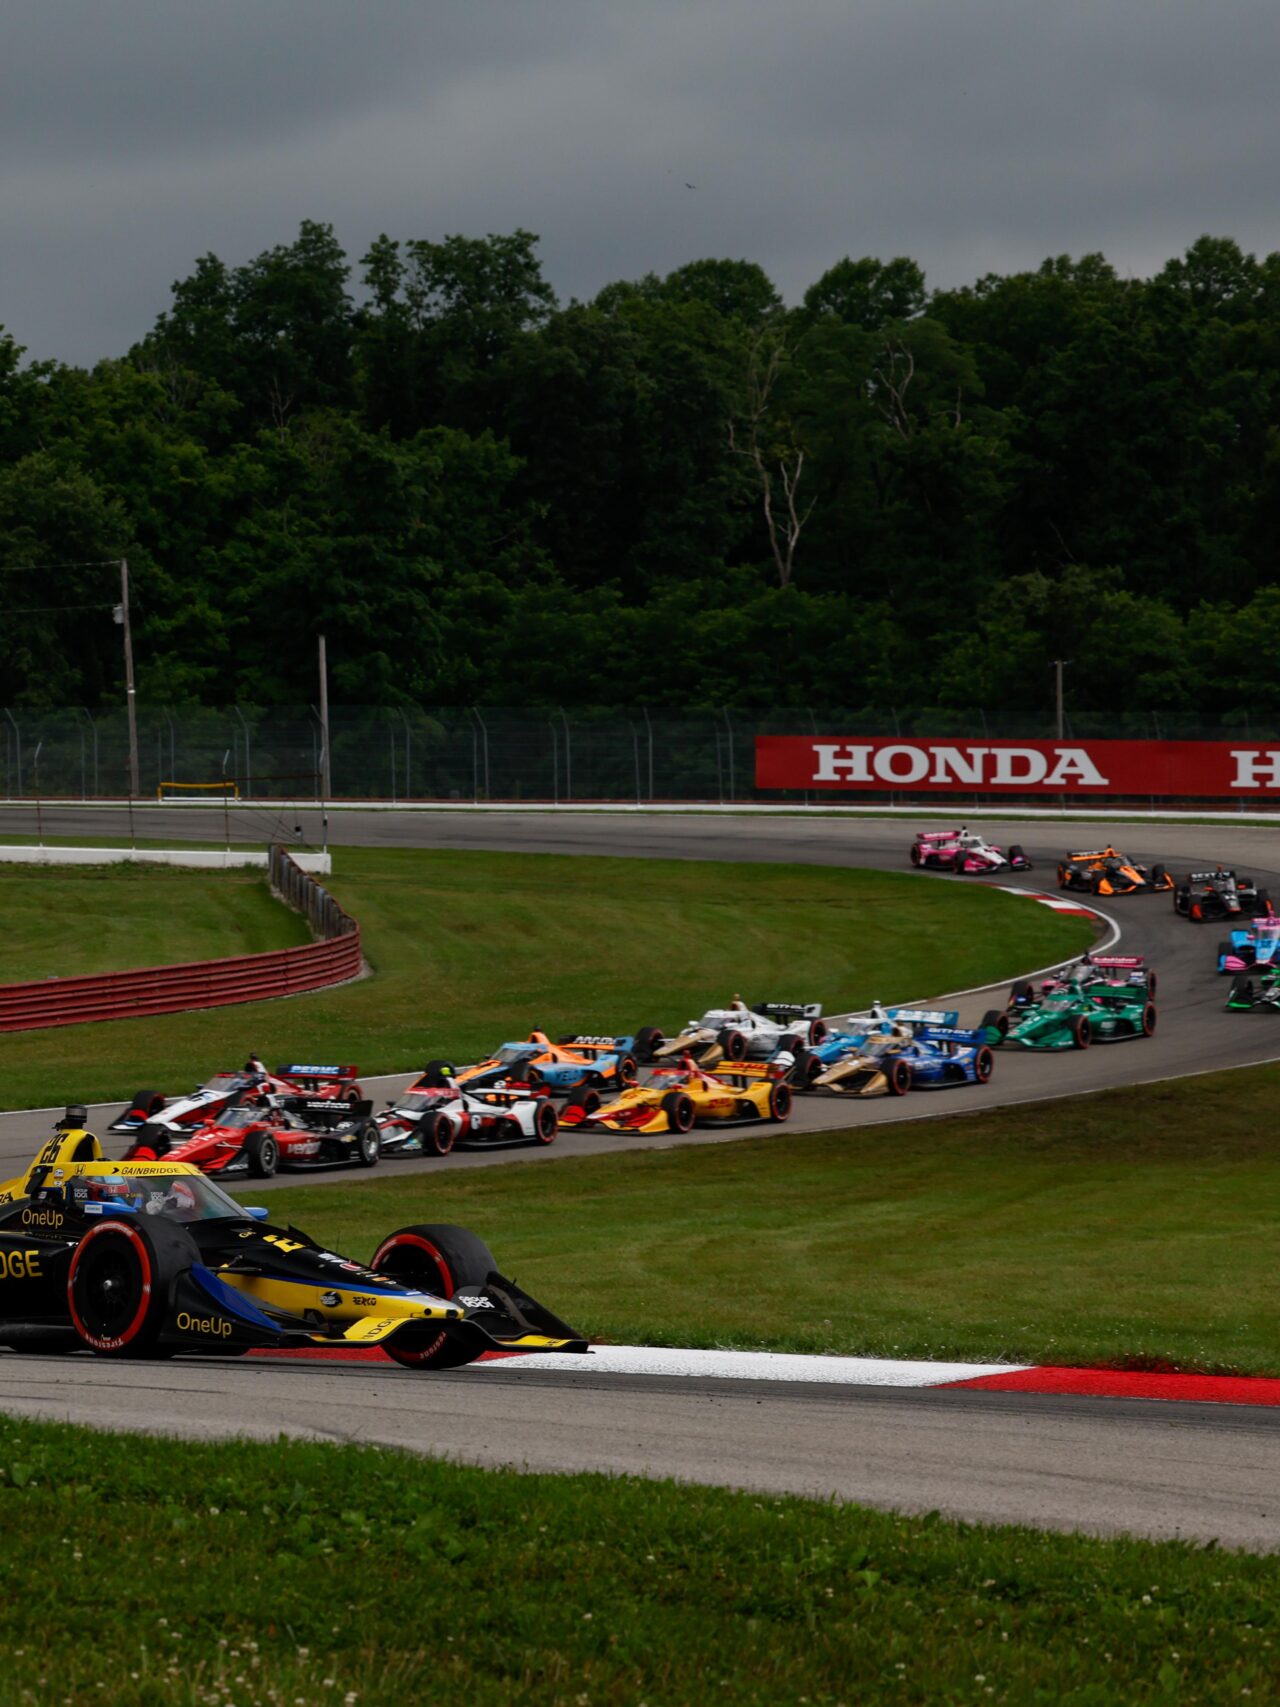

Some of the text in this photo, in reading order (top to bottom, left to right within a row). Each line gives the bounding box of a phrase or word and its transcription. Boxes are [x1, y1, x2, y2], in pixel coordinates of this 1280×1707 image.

[812, 744, 1109, 786] HONDA
[121, 1167, 180, 1175] GAINBRIDGE
[22, 1209, 64, 1228] OneUp
[176, 1312, 233, 1339] OneUp
